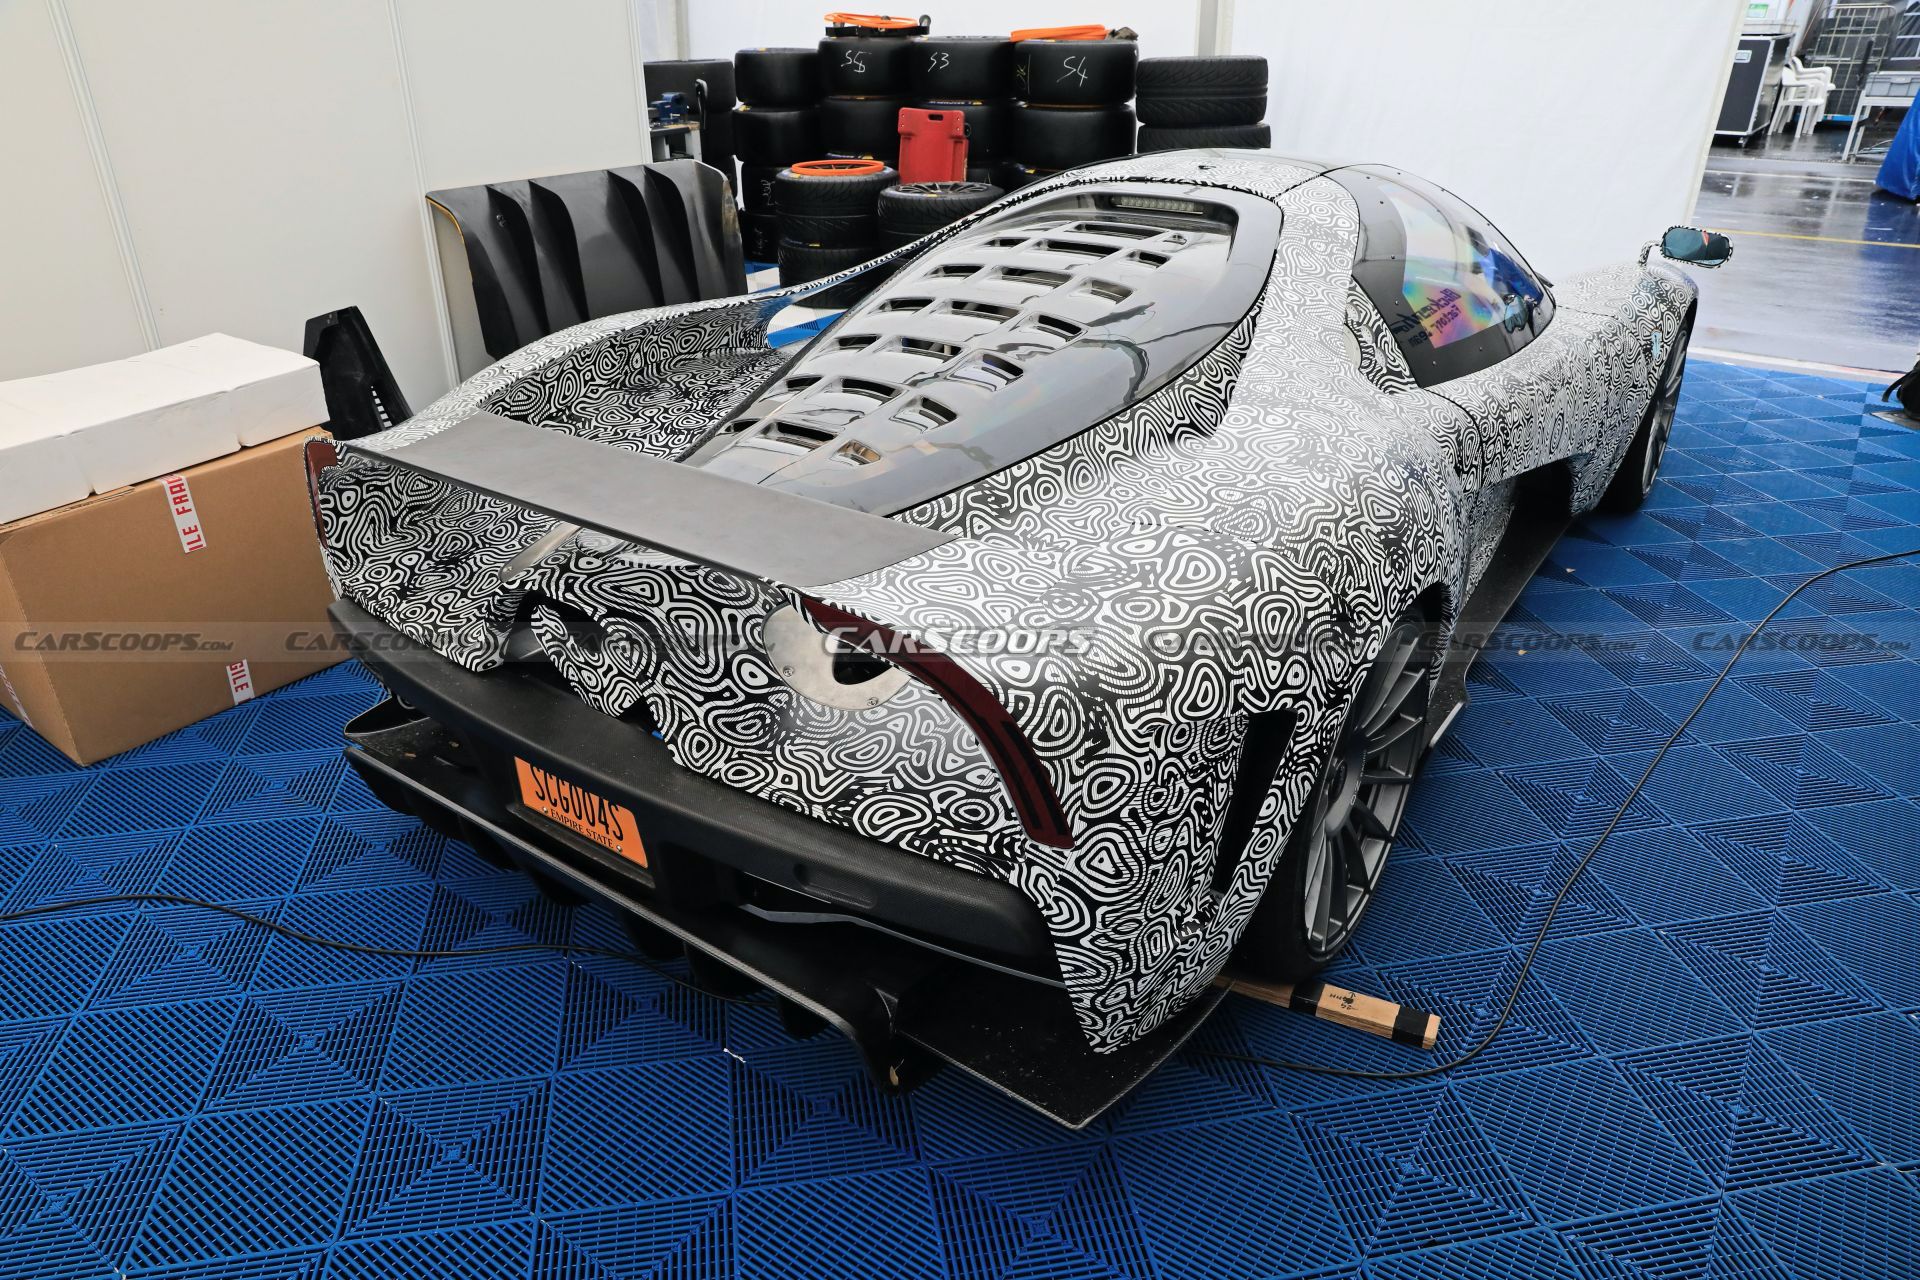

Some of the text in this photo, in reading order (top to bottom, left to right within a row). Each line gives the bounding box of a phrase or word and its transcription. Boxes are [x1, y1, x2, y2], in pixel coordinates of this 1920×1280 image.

[928, 51, 950, 72] S3
[1056, 56, 1089, 87] S4
[550, 808, 614, 849] EMPIRE STATE
